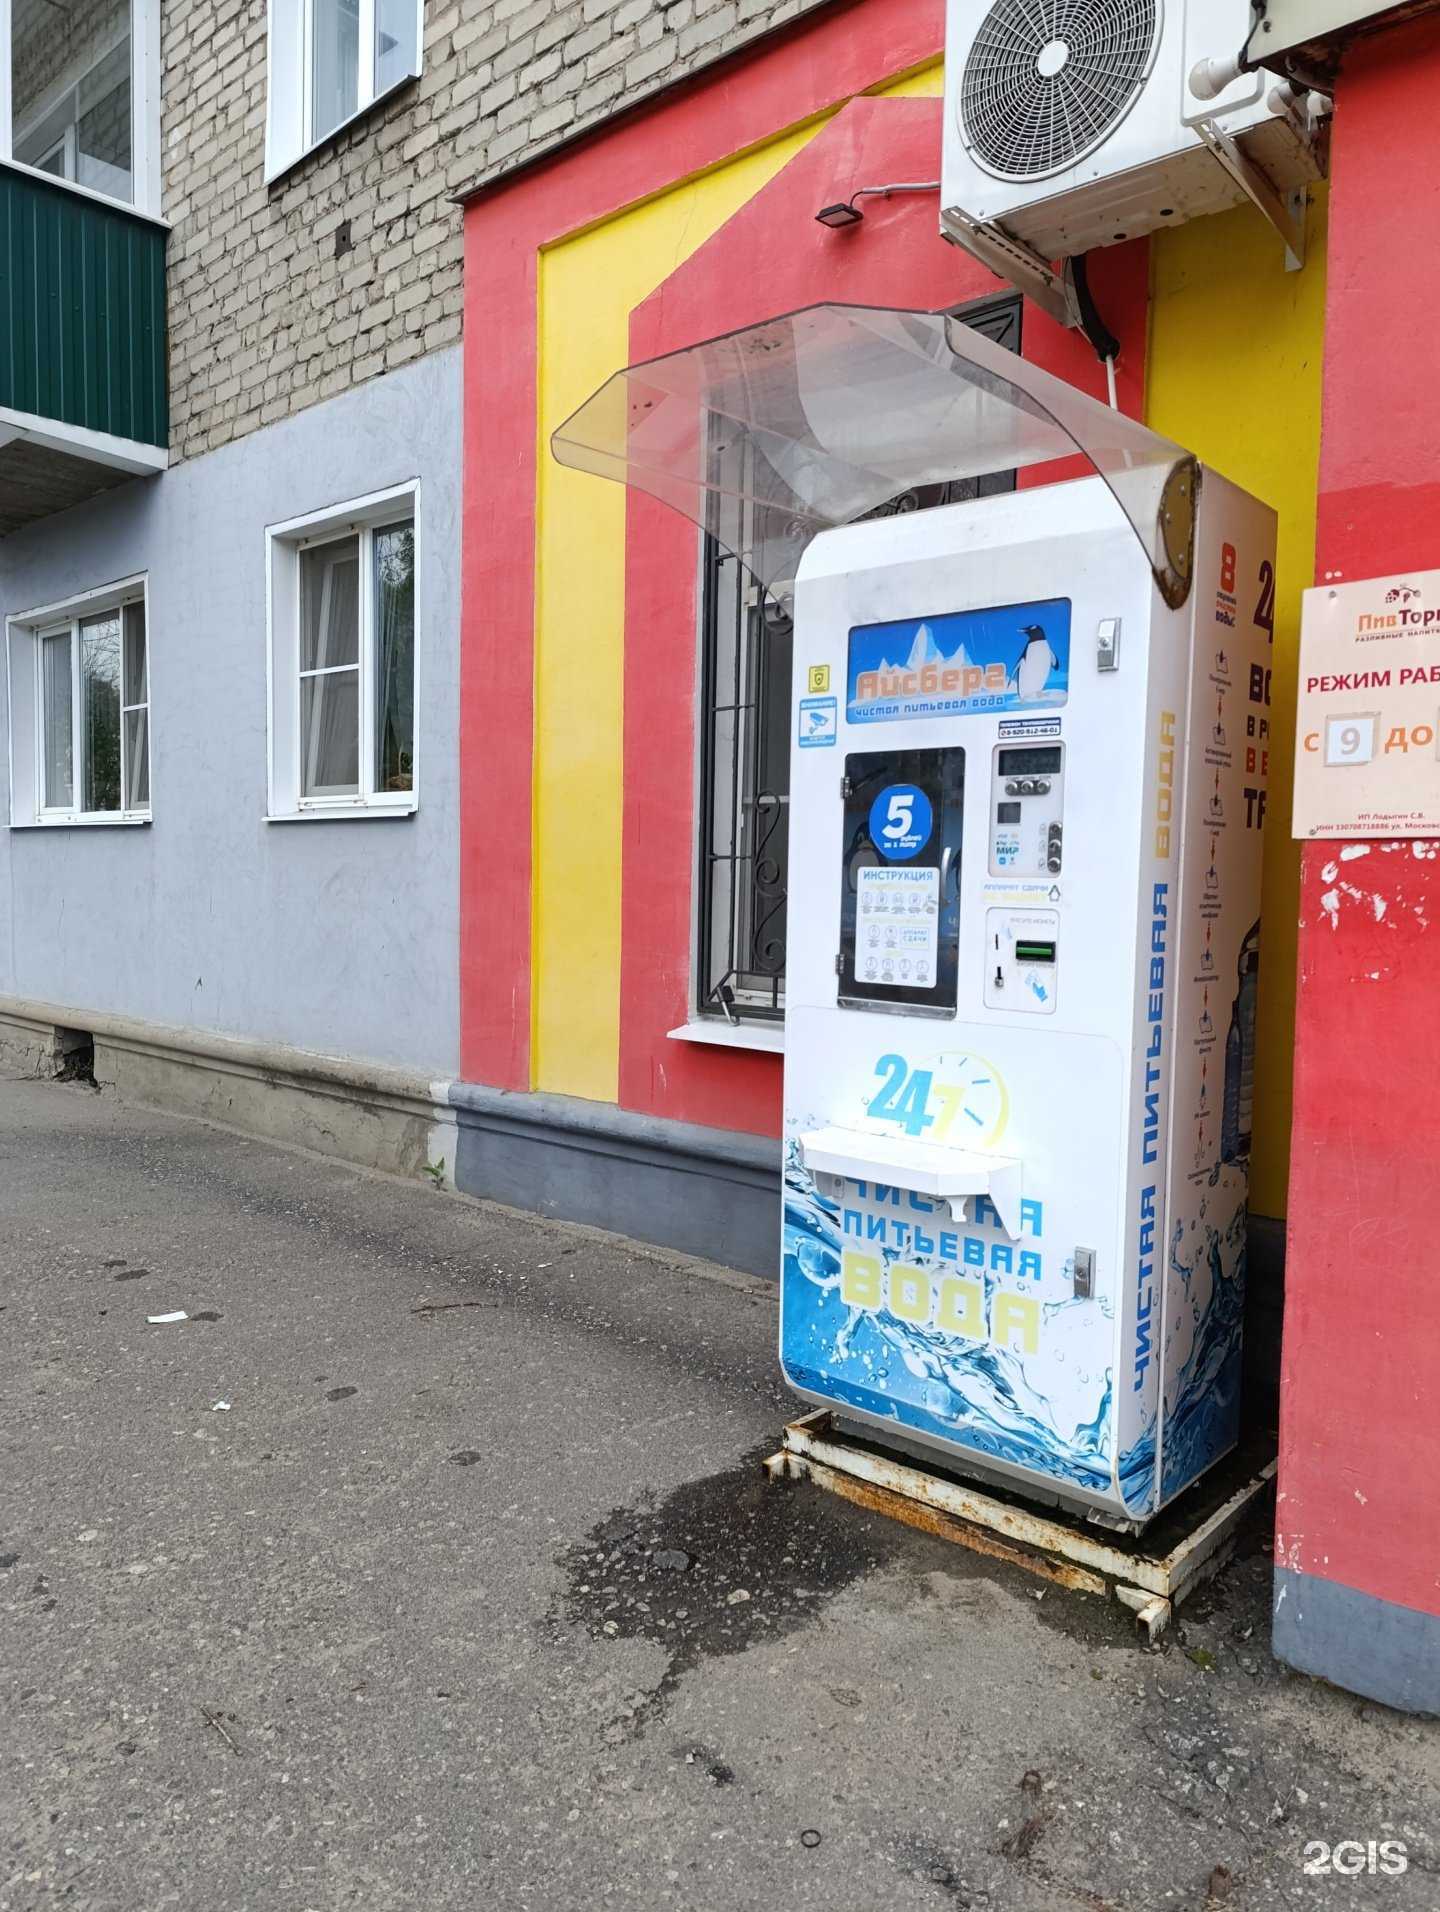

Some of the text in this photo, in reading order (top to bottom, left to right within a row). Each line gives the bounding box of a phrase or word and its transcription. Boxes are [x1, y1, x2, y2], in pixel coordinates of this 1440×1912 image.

[855, 695, 1004, 717] чистая питьевая вода
[1307, 670, 1391, 693] РЕЖИМ
[1340, 727, 1361, 755] 9
[1384, 725, 1434, 753] до
[1155, 711, 1176, 859] ВОДА
[881, 794, 915, 839] 5
[863, 870, 934, 882] ИНСТРУКЦИЯ
[1142, 883, 1169, 1165] ПИТЬЕВАЯ
[844, 1208, 1042, 1281] ПИТЬЕВАЯ
[843, 1252, 1040, 1355] ВОДА
[1133, 1184, 1157, 1393] ЧИСТАЯ
